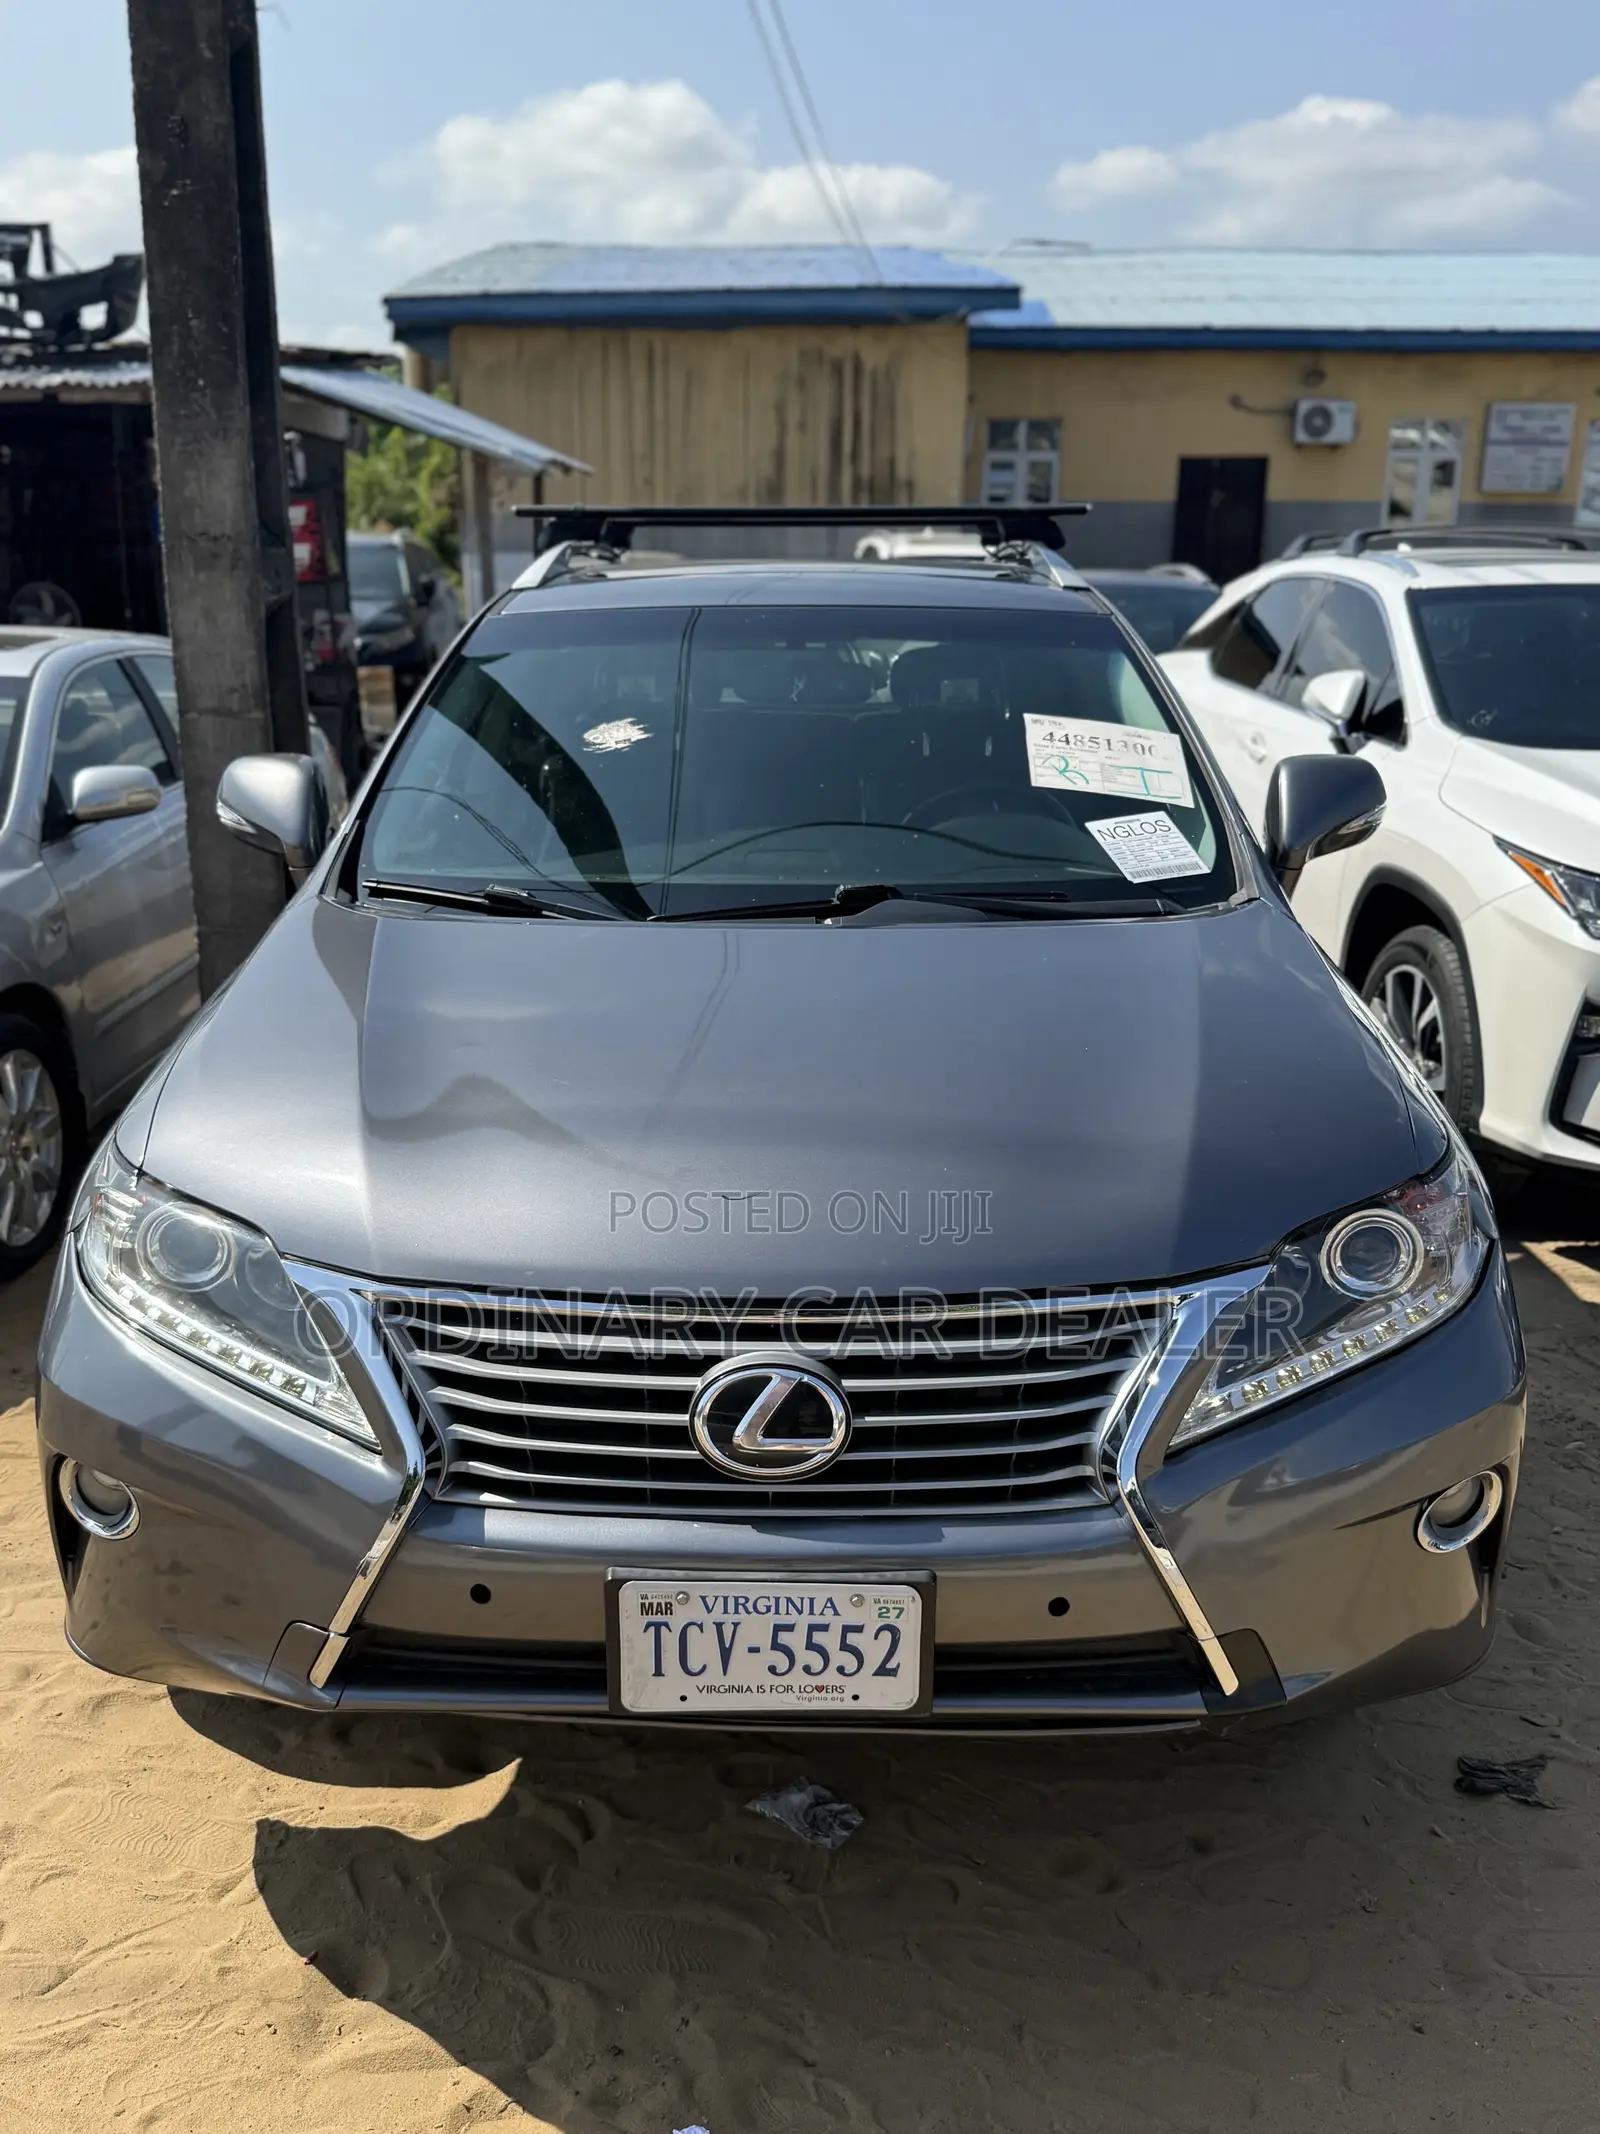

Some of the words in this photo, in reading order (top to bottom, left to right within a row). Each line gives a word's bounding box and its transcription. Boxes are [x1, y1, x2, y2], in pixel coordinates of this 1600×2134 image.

[1097, 819, 1172, 842] NGLOS
[640, 1601, 674, 1616] MAR
[698, 1595, 841, 1617] VIRGINIA
[877, 1606, 905, 1619] 27
[643, 1621, 901, 1678] TCV-5552
[696, 1684, 754, 1694] VIRGINIA
[756, 1684, 766, 1694] IS
[769, 1684, 795, 1694] FOR
